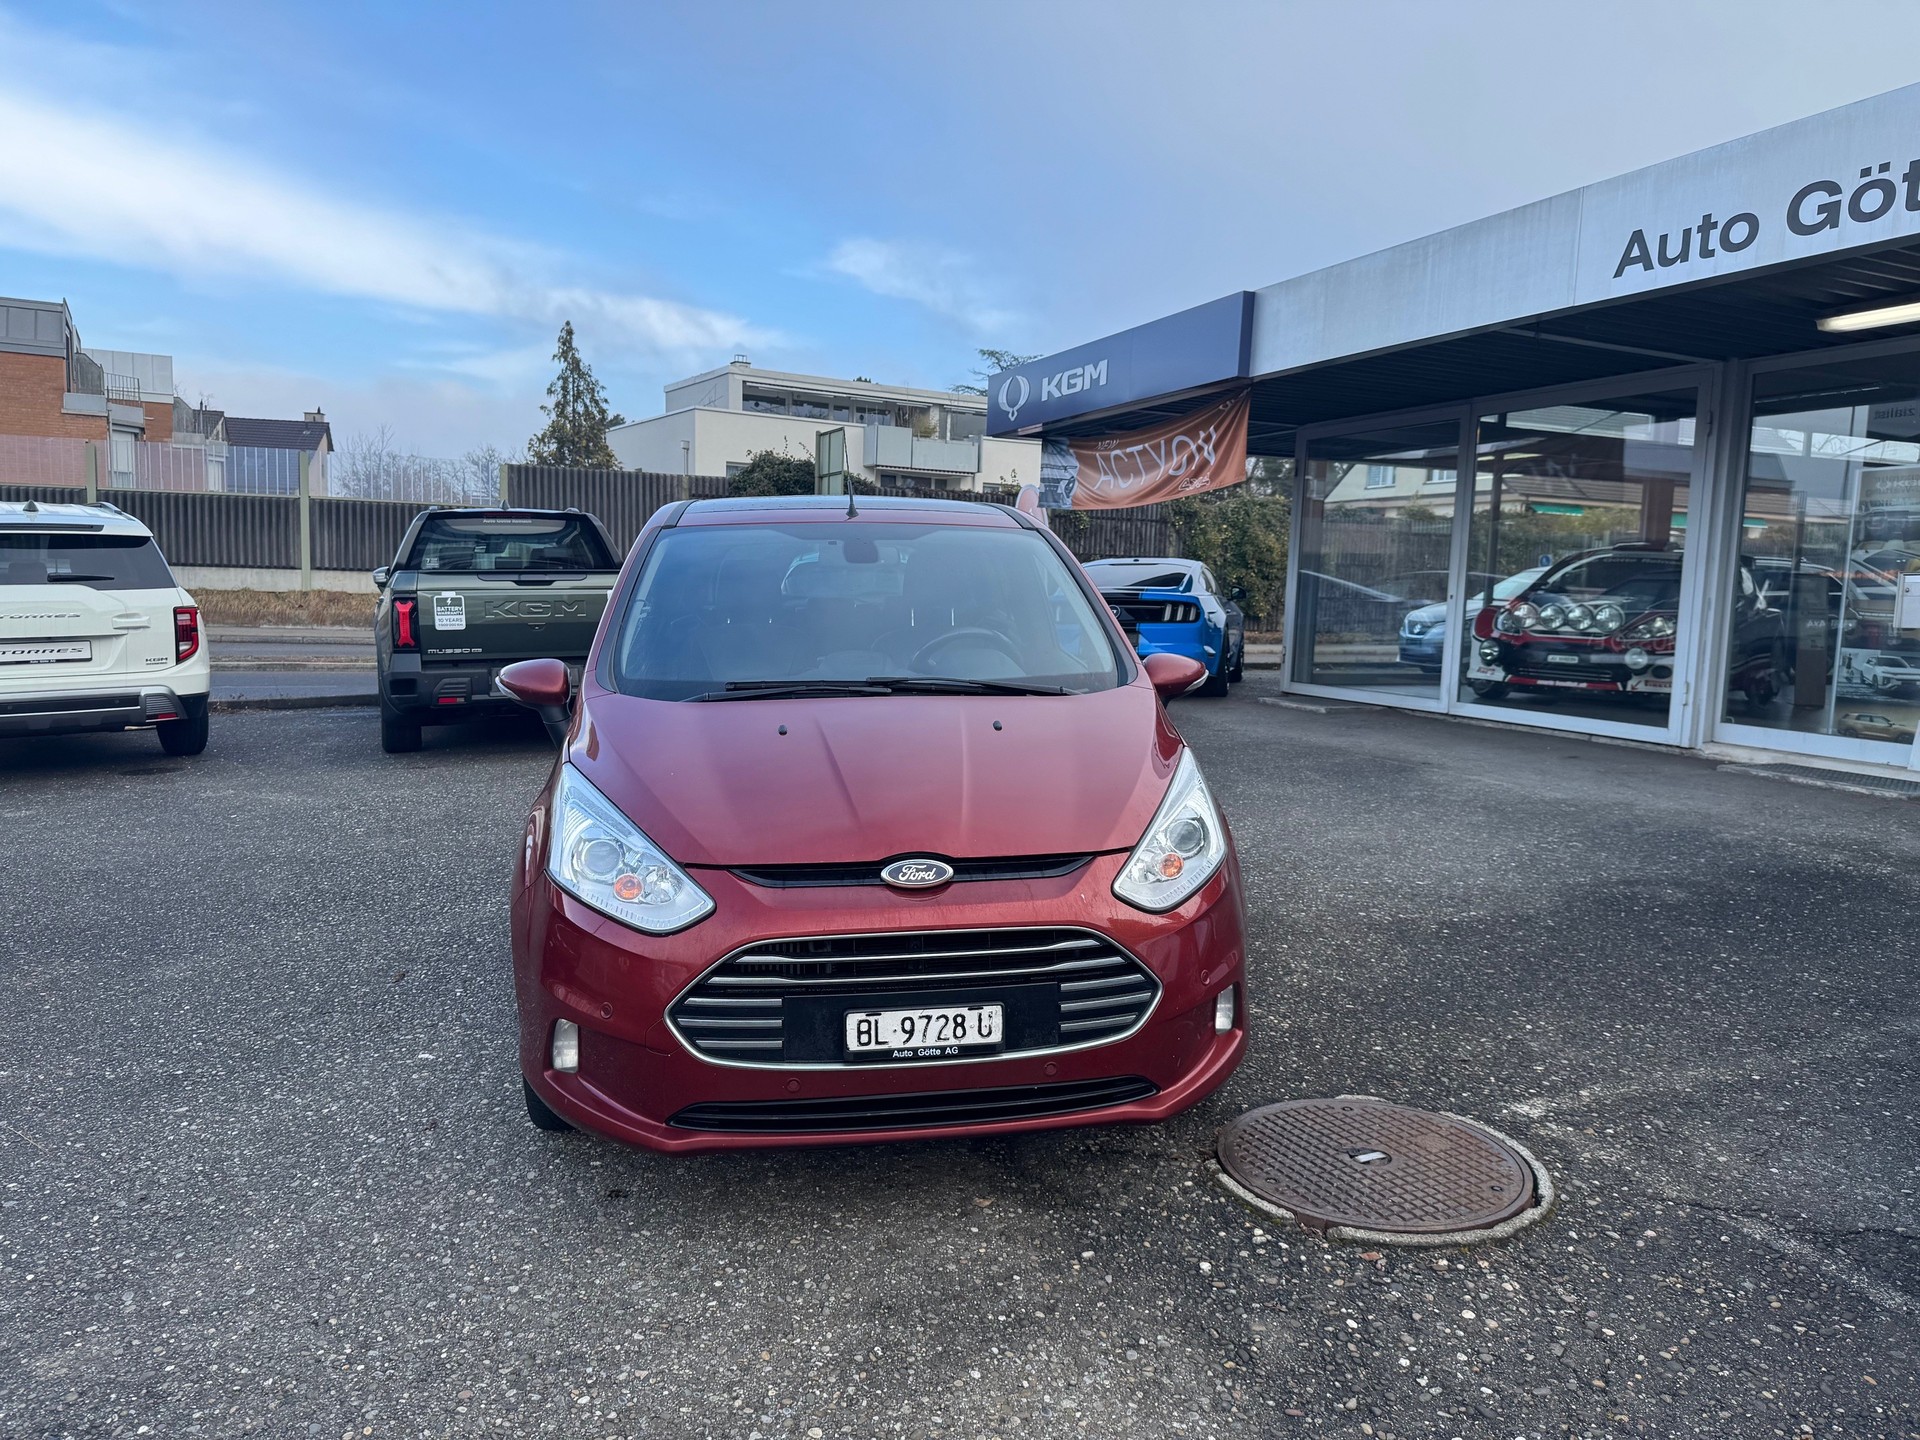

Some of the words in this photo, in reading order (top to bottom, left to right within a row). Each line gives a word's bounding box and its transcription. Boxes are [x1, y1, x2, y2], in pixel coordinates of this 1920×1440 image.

[1611, 211, 1760, 280] Auto
[1041, 359, 1109, 402] KGM
[1095, 438, 1120, 450] NEW
[1093, 425, 1218, 491] ACTYON
[484, 600, 587, 618] KGM
[898, 864, 937, 882] Ford
[856, 1018, 889, 1047] BL
[900, 1013, 967, 1046] 9728
[892, 1049, 913, 1058] Auto
[917, 1047, 941, 1057] Götte
[945, 1046, 959, 1055] AG
